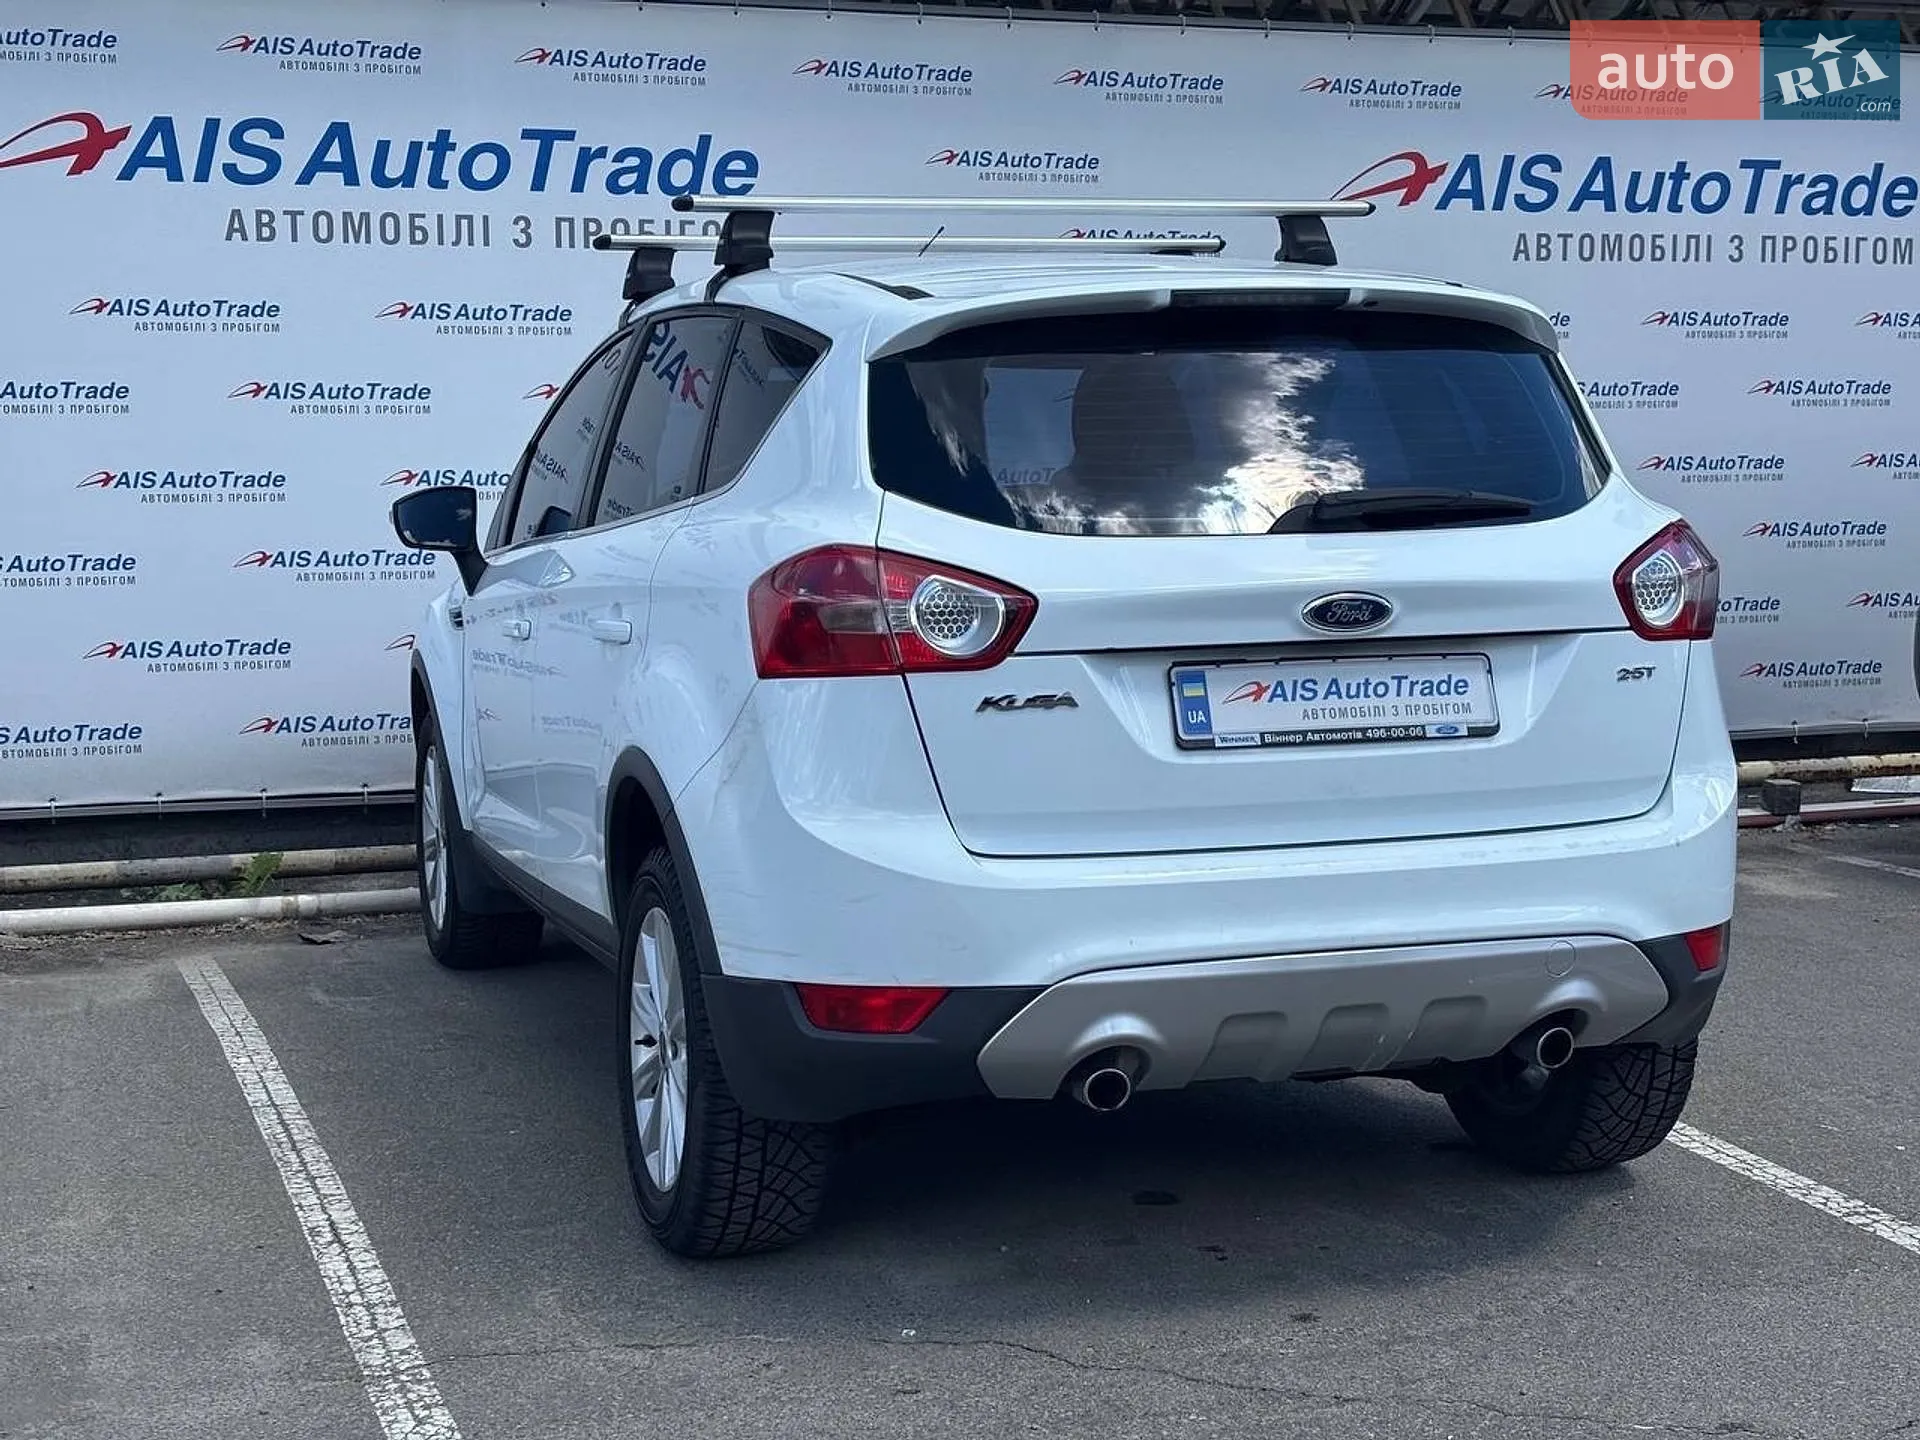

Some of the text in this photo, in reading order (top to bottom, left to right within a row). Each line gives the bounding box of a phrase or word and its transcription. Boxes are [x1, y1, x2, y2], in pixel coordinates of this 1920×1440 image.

[0, 29, 117, 48] AutoTrade
[0, 50, 40, 61] МОБІЛІ
[57, 53, 116, 64] ПРОБІГОМ
[253, 37, 421, 60] AIS AutoTrade
[280, 60, 349, 72] АВТОМОБІЛІ
[365, 63, 421, 74] ПРОБІГОМ
[549, 49, 706, 71] AIS AutoTrade
[573, 72, 638, 84] АВТОМОБІЛІ
[653, 75, 705, 86] ПРОБІГОМ
[827, 61, 972, 82] AIS AutoTrade
[848, 83, 908, 94] АВТОМОБІЛІ
[923, 86, 971, 96] ПРОБІГОМ
[1085, 71, 1223, 91] AIS AutoTrade
[1329, 78, 1461, 97] AIS AutoTrade
[117, 116, 758, 197] AIS AutoTrade
[958, 151, 1099, 170] AIS AutoTrade
[978, 172, 1037, 181] АВТОМОБІЛІ
[1051, 174, 1098, 183] ПРОБІГОМ
[1436, 154, 1918, 218] AIS AutoTrade
[225, 209, 490, 247] АВТОМОБІЛІ
[555, 217, 723, 249] ПРОБІГО
[1513, 233, 1712, 262] АВТОМОБІЛІ
[1761, 236, 1913, 264] ПРОБІГОМ
[107, 299, 280, 318] AIS AutoTrade
[410, 303, 572, 321] AIS AutoTrade
[135, 322, 205, 332] АВТОМОБІЛІ
[222, 323, 279, 332] ПРОБІГОМ
[1668, 311, 1789, 326] AIS AutoTrade
[1880, 313, 1910, 327] AIS
[437, 325, 502, 335] АВТОМОБІЛІ
[518, 326, 571, 336] ПРОБІГОМ
[0, 382, 129, 399] AutoTrade
[264, 383, 431, 400] AIS AutoTrade
[1587, 381, 1679, 396] AutoTrade
[1774, 380, 1891, 395] AIS AutoTrade
[3, 405, 52, 414] ОМОБІЛІ
[70, 404, 129, 414] ПРОБІГОМ
[290, 405, 359, 414] АВТОМОБІЛІ
[376, 405, 430, 415] ПРОБІГОМ
[1663, 455, 1784, 470] AIS AutoTrade
[1876, 453, 1904, 468] AIS
[114, 471, 285, 488] AIS AutoTrade
[415, 469, 455, 486] AIS
[141, 493, 211, 503] АВТОМОБІЛІ
[229, 493, 285, 502] ПРОБІГОМ
[1769, 521, 1886, 537] AIS AutoTrade
[6, 554, 136, 572] AutoTrade
[271, 550, 434, 568] AIS AutoTrade
[4, 578, 59, 587] ТОМОБІЛІ
[77, 576, 135, 586] ПРОБІГОМ
[296, 572, 364, 582] АВТОМОБІЛІ
[381, 570, 435, 580] ПРОБІГОМ
[1717, 597, 1780, 612] oTrade
[1872, 593, 1900, 607] AIS
[1327, 600, 1374, 622] Ford
[120, 638, 290, 659] AIS AutoTrade
[148, 662, 217, 673] АВТОМОБІЛІ
[234, 660, 291, 670] ПРОБІГОМ
[1765, 660, 1882, 677] AIS AutoTrade
[1268, 674, 1469, 703] AIS AutoTrade
[975, 694, 1080, 713] KUGA
[1303, 705, 1385, 720] АВТОМОБІЛІ
[1405, 703, 1471, 716] ПРОБІГОМ
[275, 714, 410, 733] AIS AutoTra
[1188, 710, 1207, 724] UA
[13, 723, 142, 743] AutoTrade
[302, 736, 368, 747] АВТОМОБІЛІ
[385, 734, 413, 744] ПРОБ
[2, 748, 66, 758] ВТОМОБІЛІ
[84, 744, 142, 755] ПРОБІГОМ
